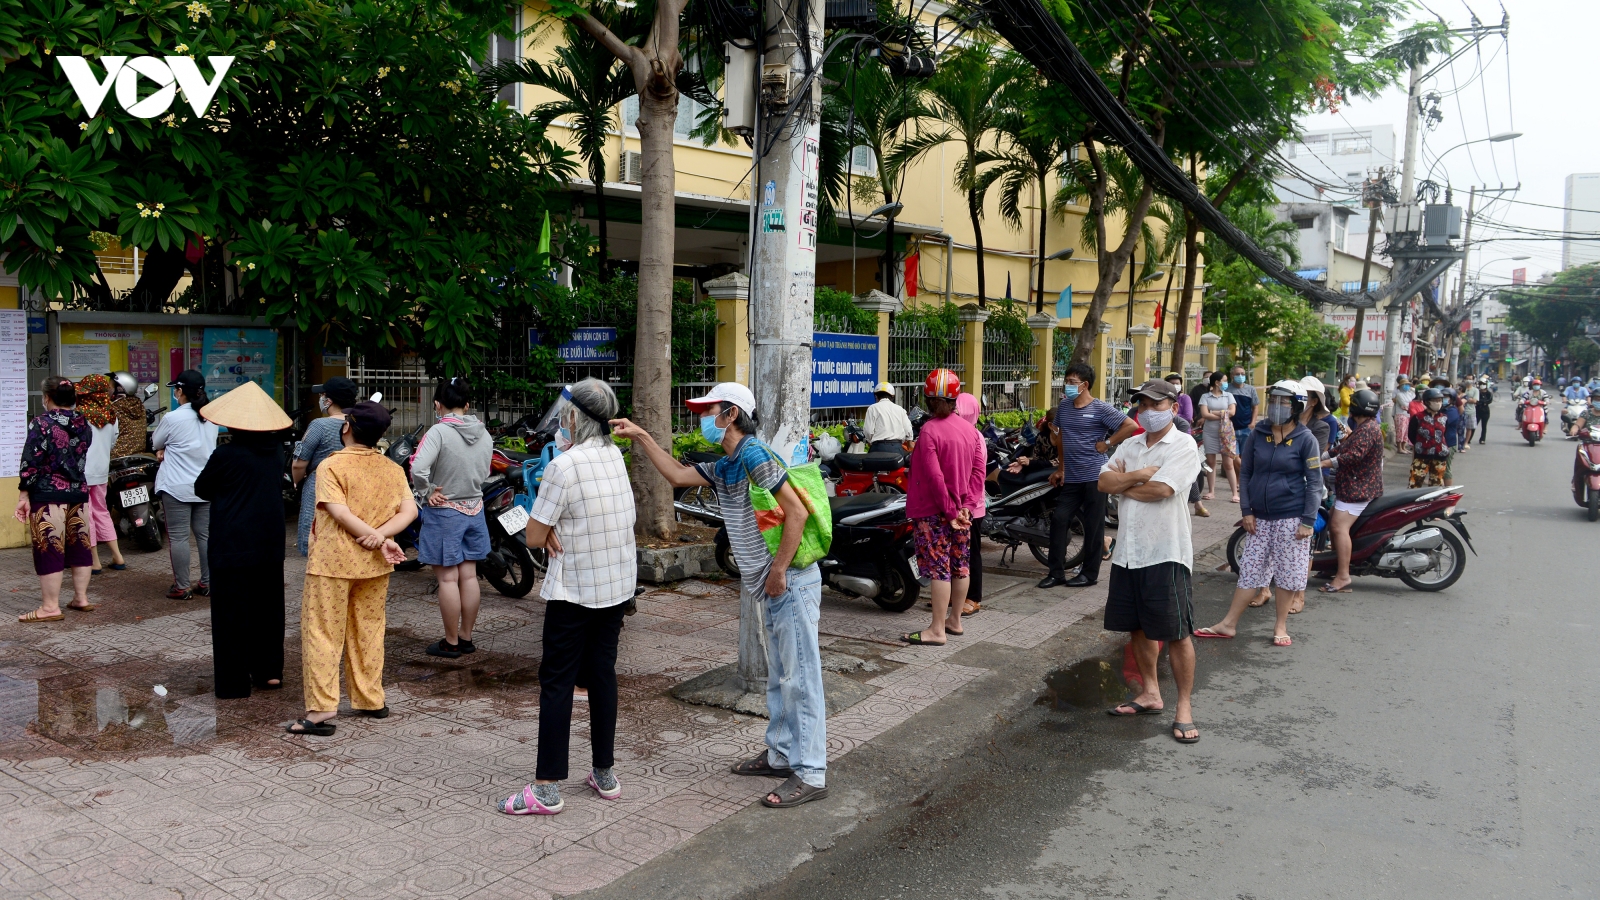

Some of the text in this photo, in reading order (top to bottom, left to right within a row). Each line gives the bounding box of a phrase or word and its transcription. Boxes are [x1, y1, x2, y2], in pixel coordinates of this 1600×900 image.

[836, 361, 851, 375] GIAO
[852, 360, 872, 375] THÔNG
[813, 380, 823, 397] NỤ
[840, 380, 858, 397] HẠNH
[858, 378, 875, 394] PHÚC
